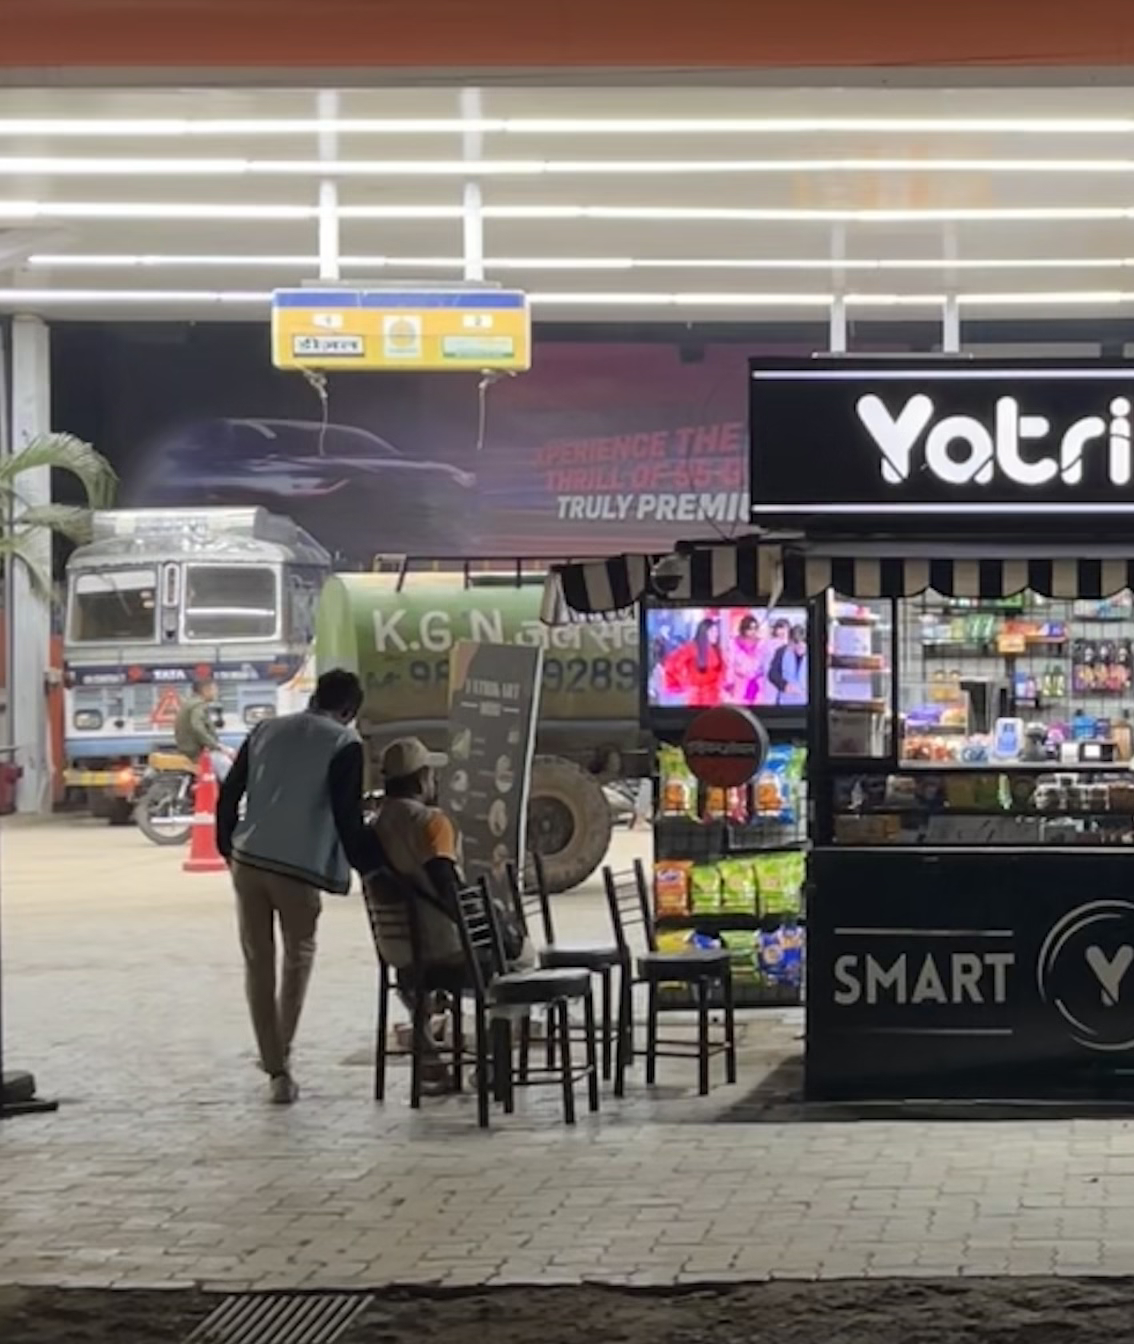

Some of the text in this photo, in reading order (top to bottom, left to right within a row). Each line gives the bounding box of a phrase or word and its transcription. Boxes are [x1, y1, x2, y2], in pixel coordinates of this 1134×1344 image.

[676, 422, 743, 453] THE
[546, 463, 622, 492] THRILL
[631, 462, 667, 489] OF
[558, 493, 633, 520] TRULY
[833, 952, 1015, 1005] SMART
